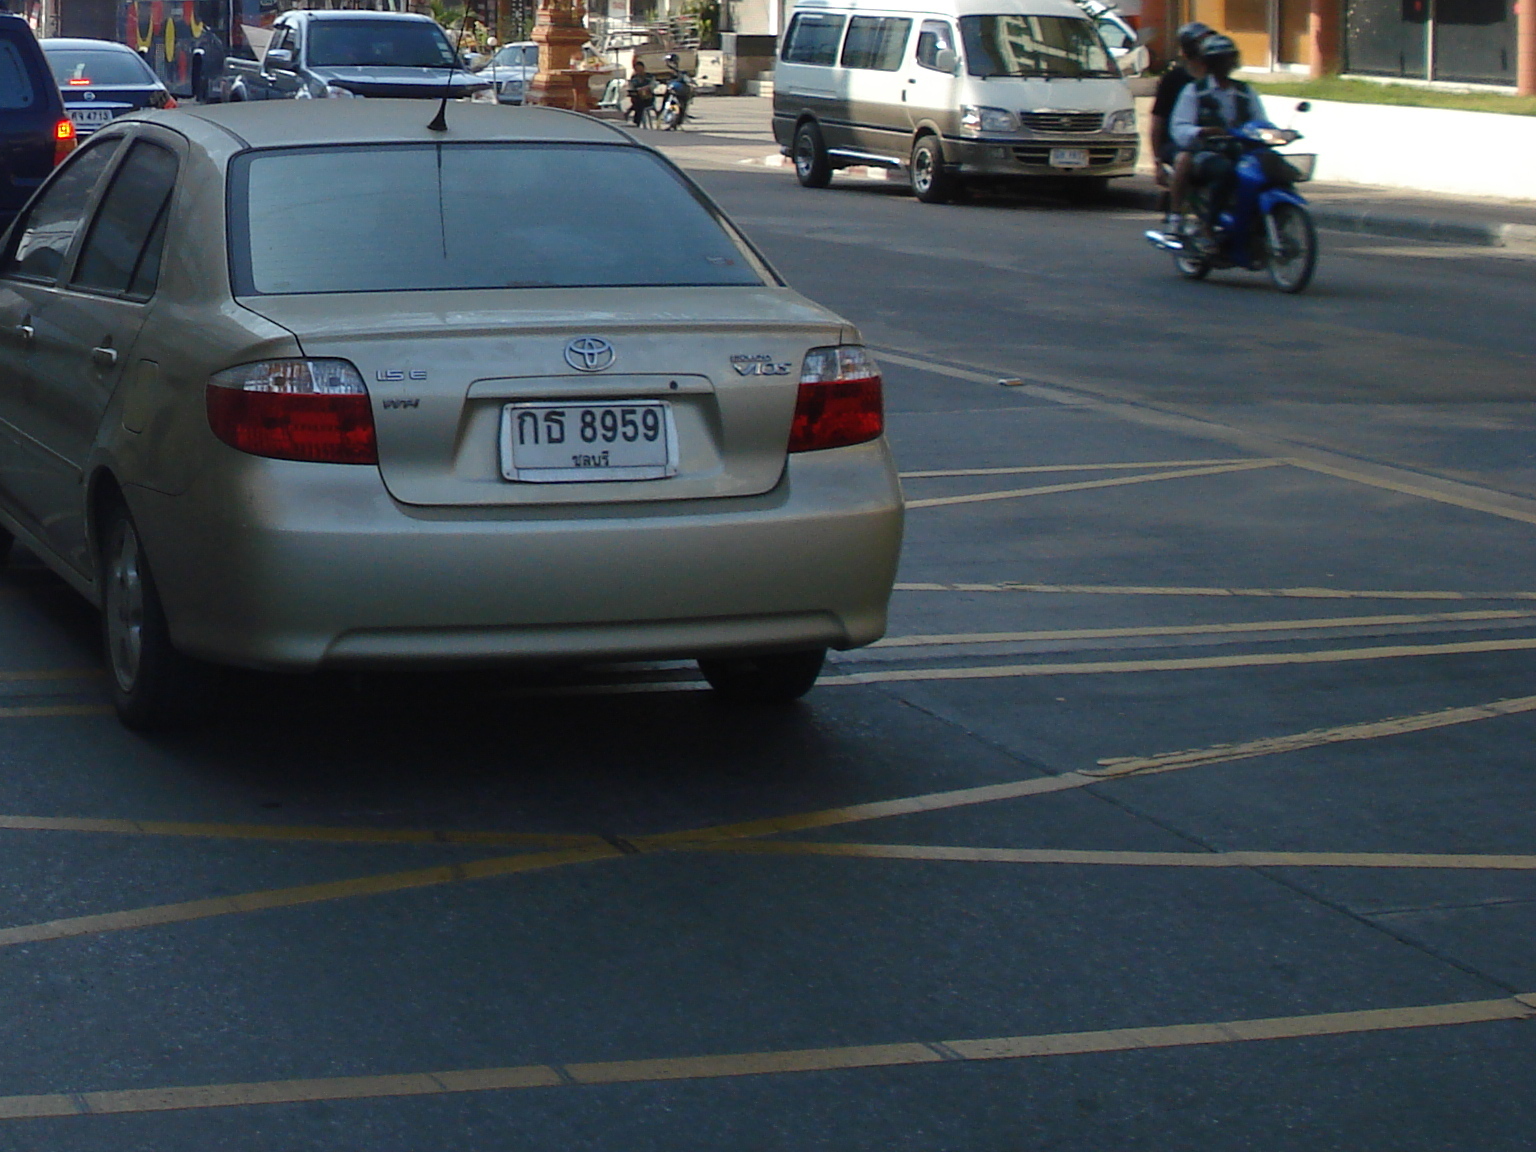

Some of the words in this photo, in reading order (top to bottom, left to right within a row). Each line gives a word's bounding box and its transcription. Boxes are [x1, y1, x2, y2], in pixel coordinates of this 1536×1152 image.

[408, 369, 428, 381] E
[733, 361, 793, 377] VIOS
[579, 406, 661, 444] 8959
